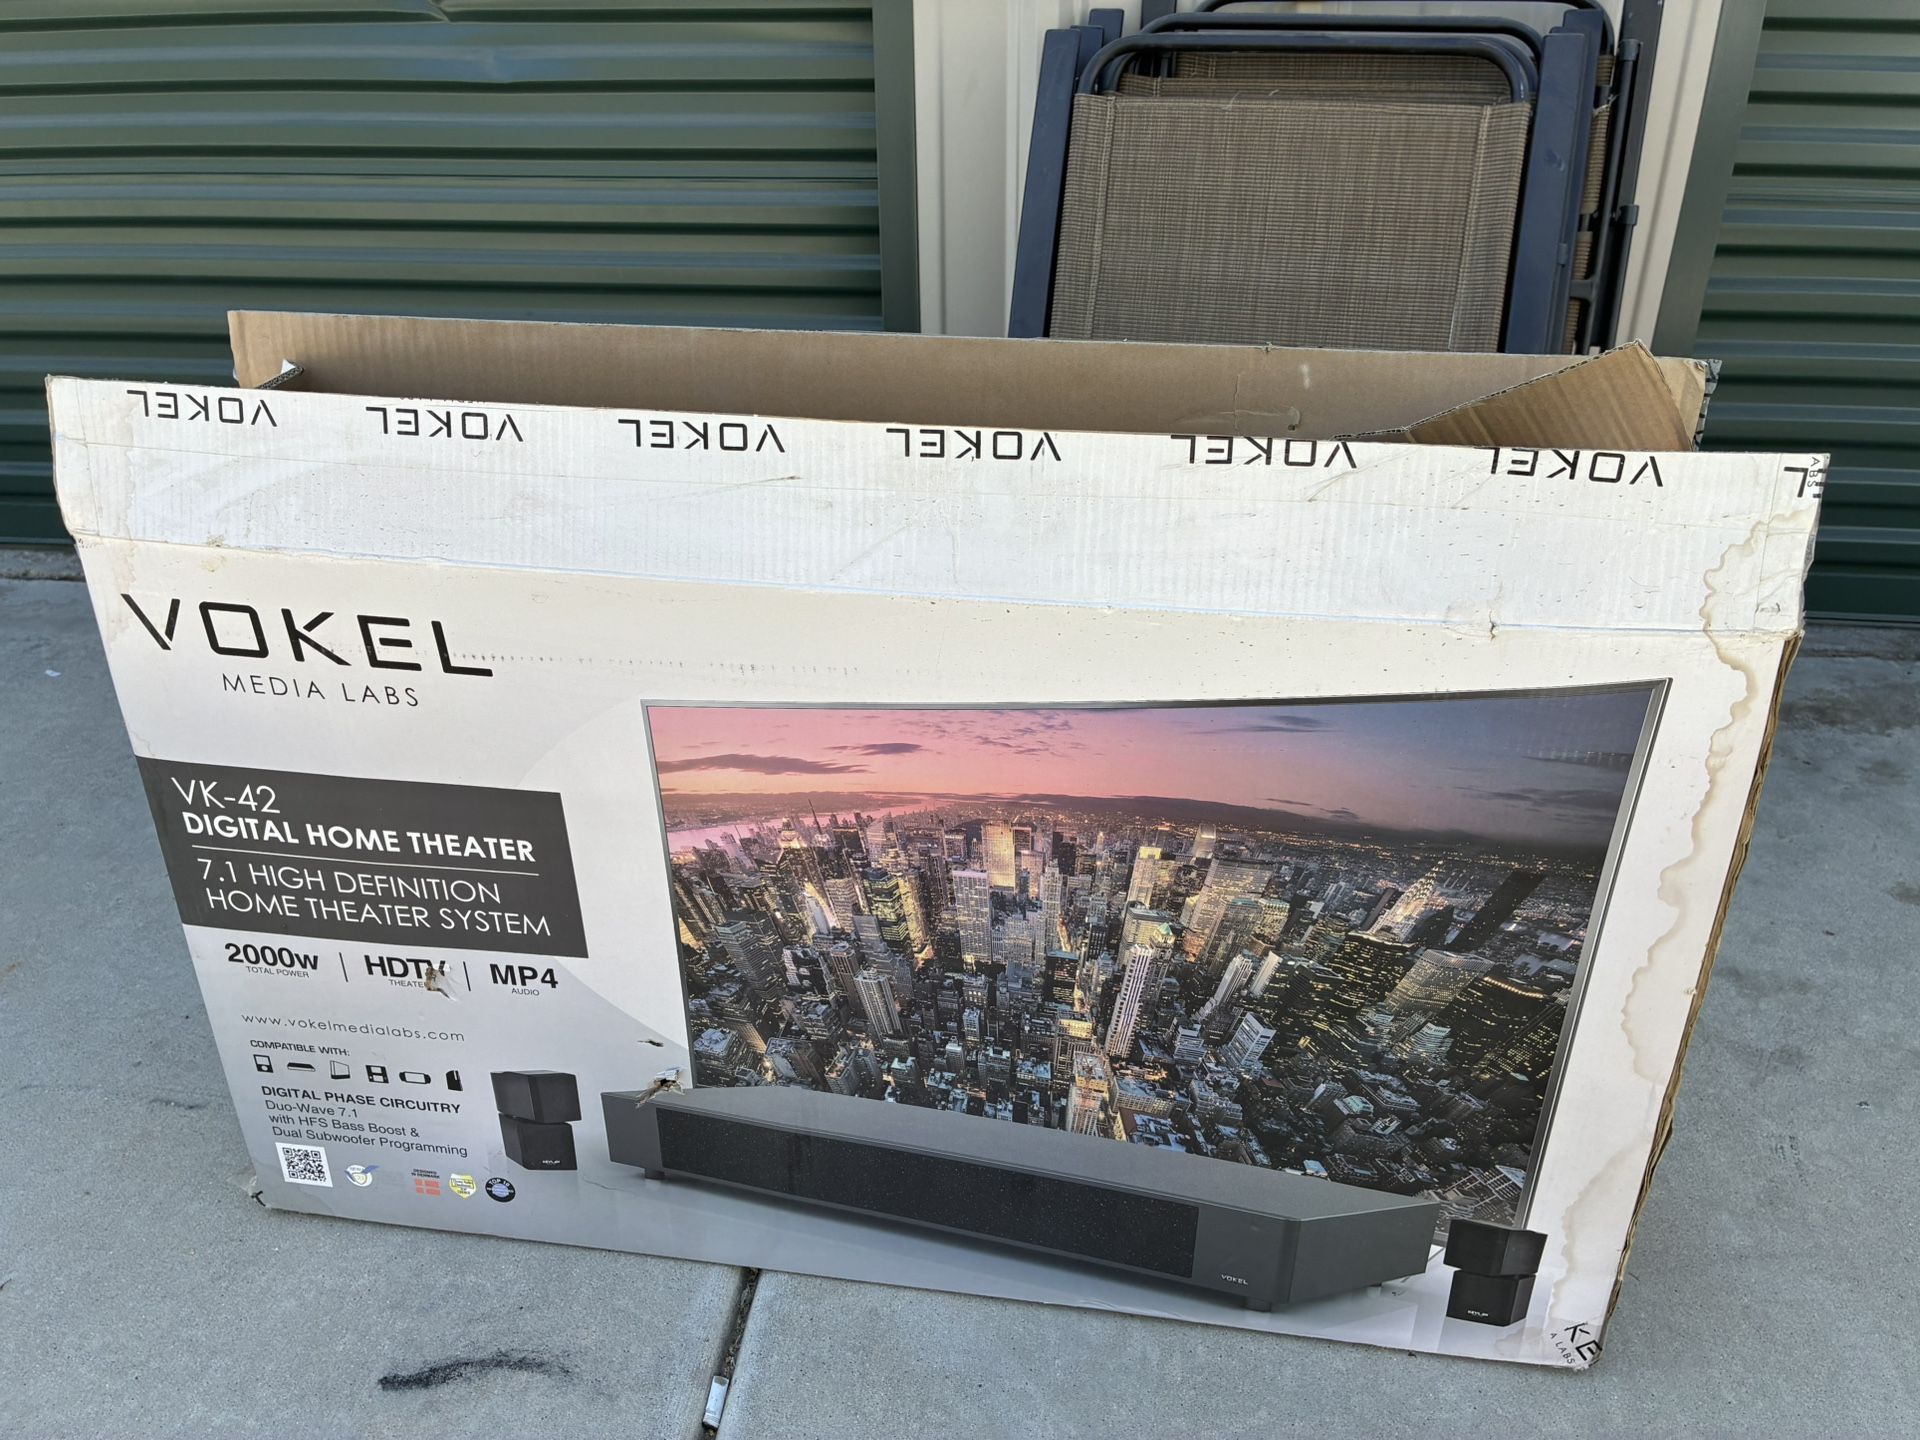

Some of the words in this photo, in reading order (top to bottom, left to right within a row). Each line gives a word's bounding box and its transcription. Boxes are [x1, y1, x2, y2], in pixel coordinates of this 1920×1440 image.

[126, 390, 277, 427] VOKEL
[365, 406, 524, 442] VOKEL
[618, 418, 786, 453] VOKEL
[886, 428, 1062, 462] VOKEL
[1171, 434, 1357, 469] VOKEL
[1474, 446, 1664, 488] VOKEL
[120, 592, 494, 678] VOKEL
[222, 672, 325, 701] MEDIA
[344, 681, 420, 708] LABS
[171, 776, 281, 814] VK-42
[182, 811, 300, 844] DIGITAL
[305, 823, 401, 853] HOME
[406, 831, 536, 862] THEATER
[197, 858, 237, 883] 7.1
[248, 863, 326, 892] HIGH
[334, 871, 501, 904] DEFINITION
[206, 887, 300, 917] HOME
[304, 897, 432, 928] THEATER
[439, 907, 551, 937] SYSTEM
[246, 965, 275, 975] TOTAL
[276, 968, 310, 978] POWER
[489, 963, 559, 989] MP4
[511, 987, 540, 996] AUDIO
[241, 1014, 465, 1042] www.vokelmedialabs.com
[250, 1039, 316, 1053] COMPATIBLE
[318, 1045, 351, 1057] WITH:
[261, 1085, 321, 1100] DIGITAL
[324, 1091, 376, 1106] PHASE
[380, 1097, 461, 1114] CIRCUITRY
[265, 1099, 336, 1116] Duo-Wave
[338, 1106, 358, 1118] 7.1
[268, 1113, 295, 1125] with
[298, 1116, 329, 1128] HFS
[332, 1119, 366, 1132] Bass
[368, 1122, 407, 1136] Boost
[410, 1127, 420, 1138] &
[272, 1126, 303, 1138] Dual
[306, 1129, 376, 1147] Subwoofer
[379, 1137, 468, 1159] Programming
[1221, 1273, 1249, 1286] VOKEL
